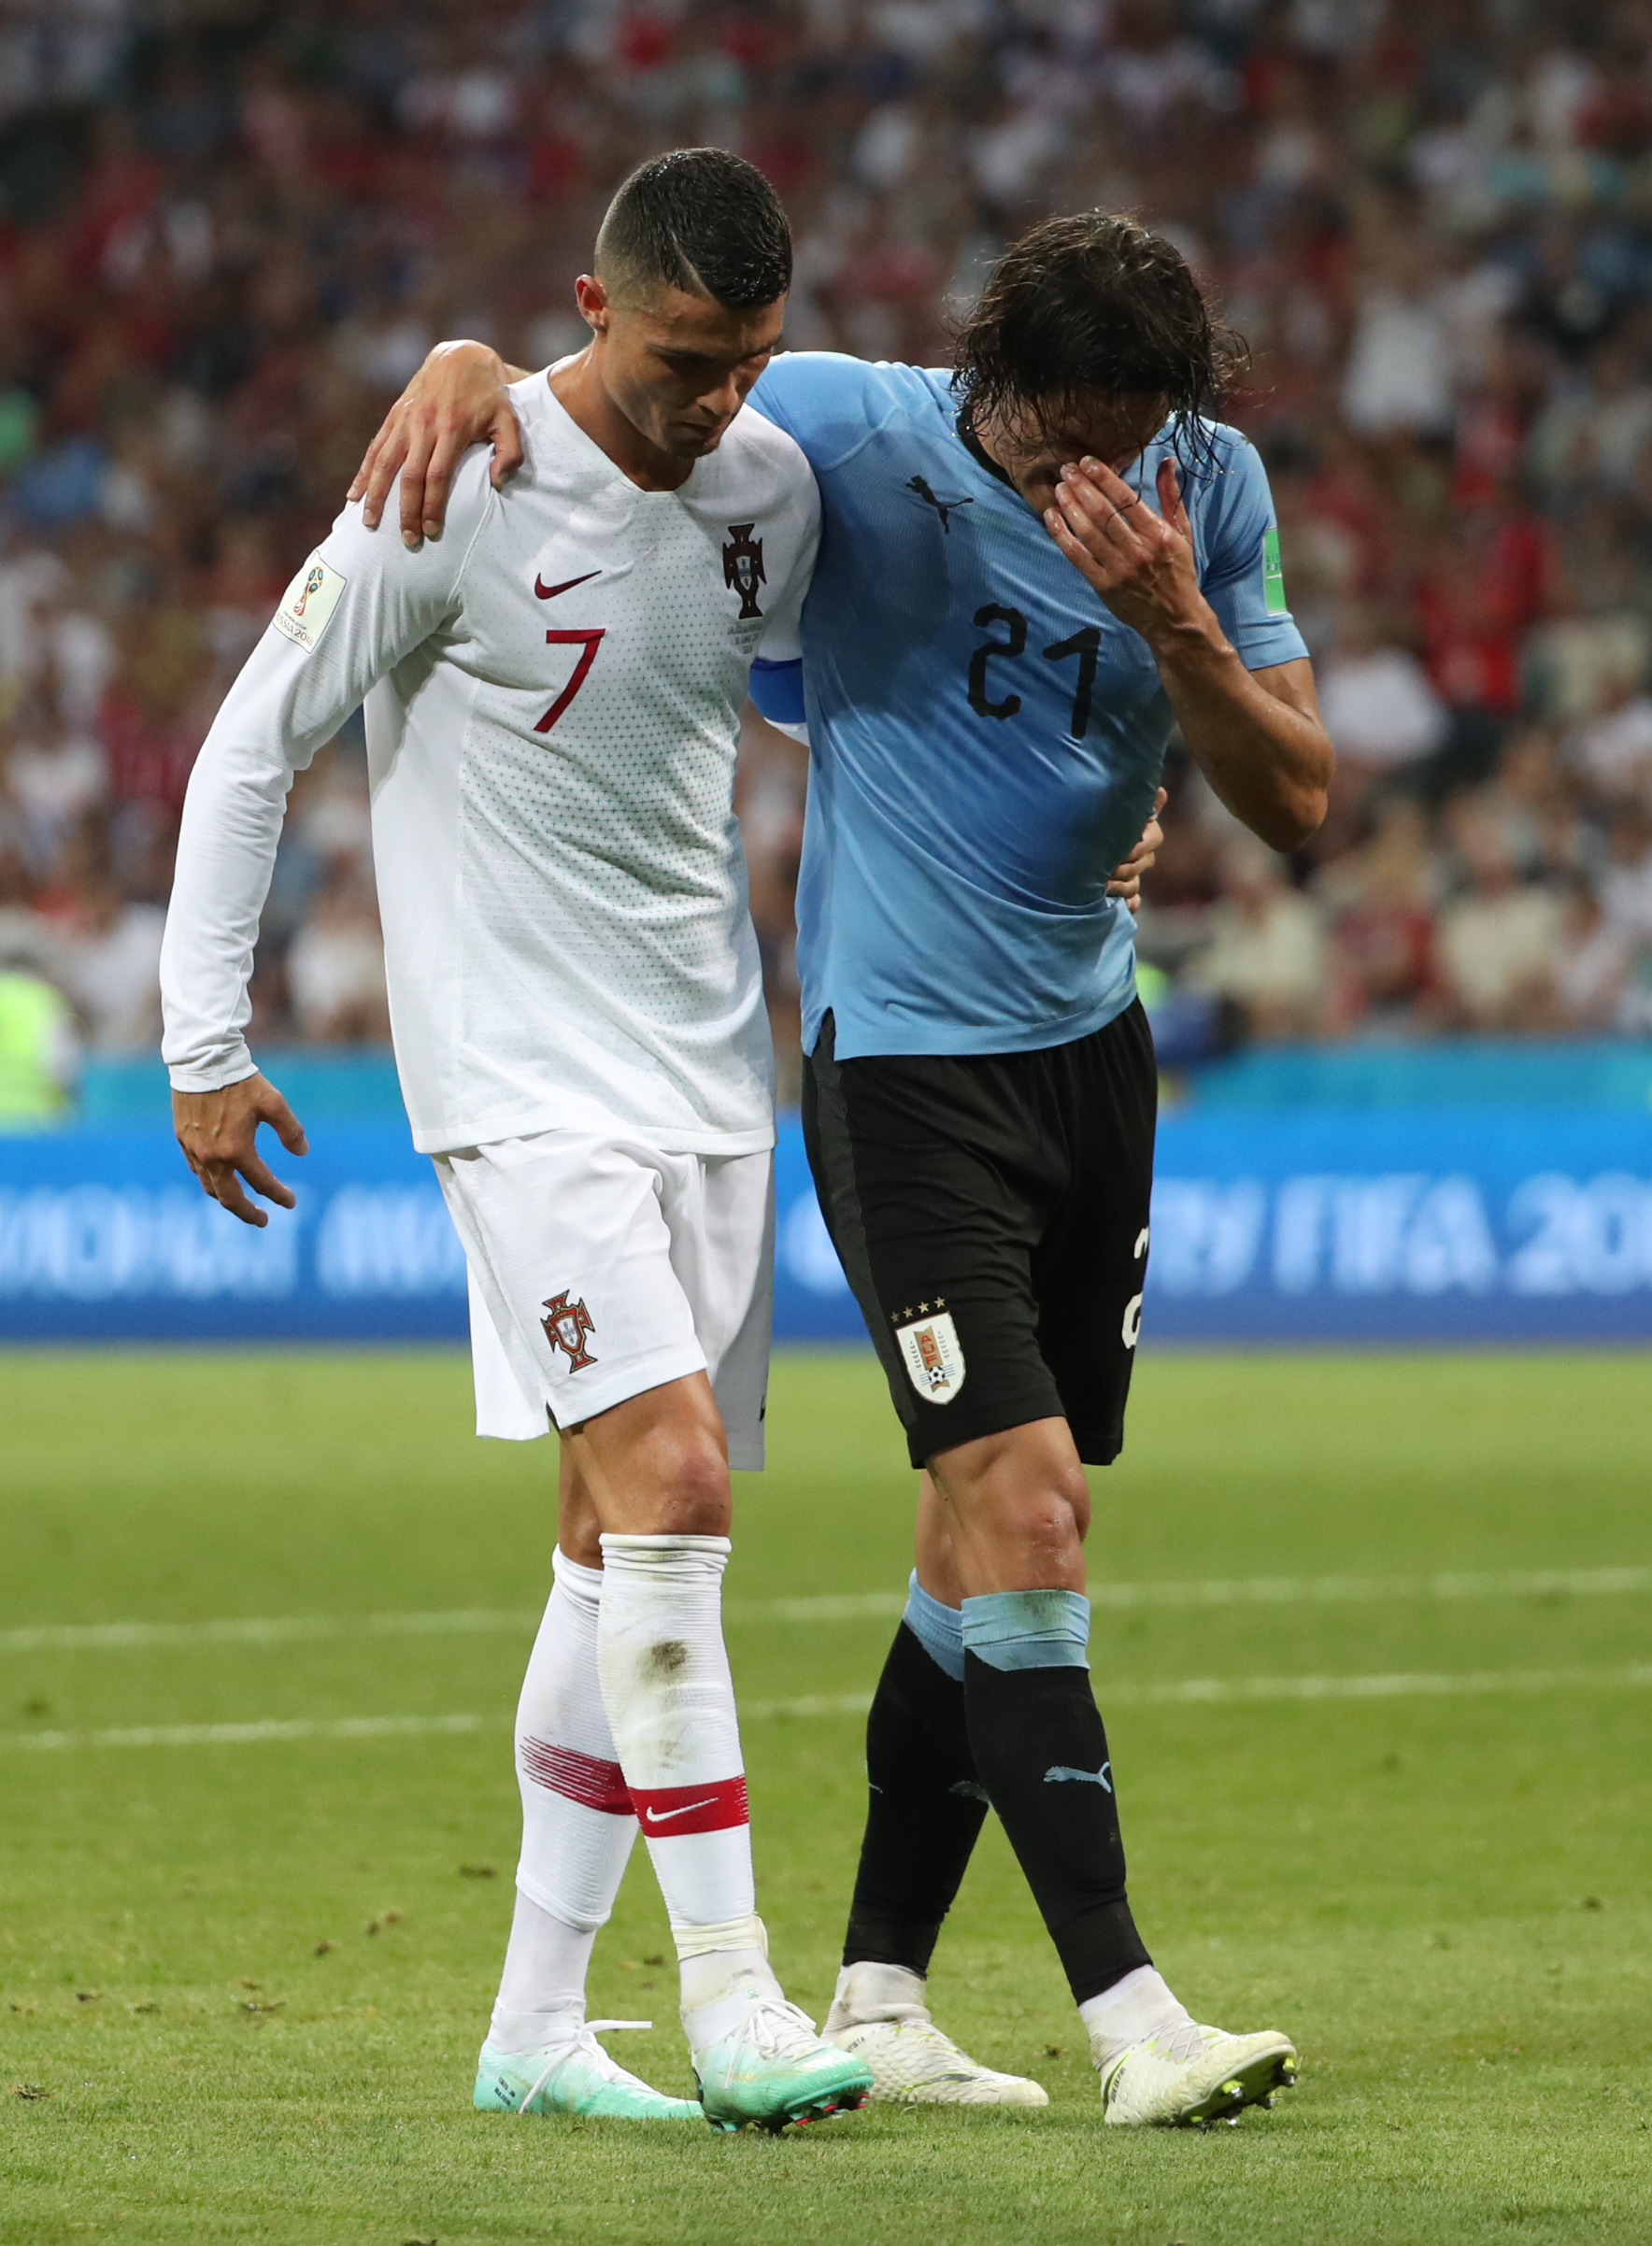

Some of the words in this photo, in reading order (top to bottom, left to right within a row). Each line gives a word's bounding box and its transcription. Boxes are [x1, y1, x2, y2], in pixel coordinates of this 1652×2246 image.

[293, 628, 314, 647] 2018
[534, 629, 605, 732] 7
[968, 602, 1102, 740] 21
[1504, 1170, 1652, 1299] 20
[920, 1334, 939, 1365] AUF
